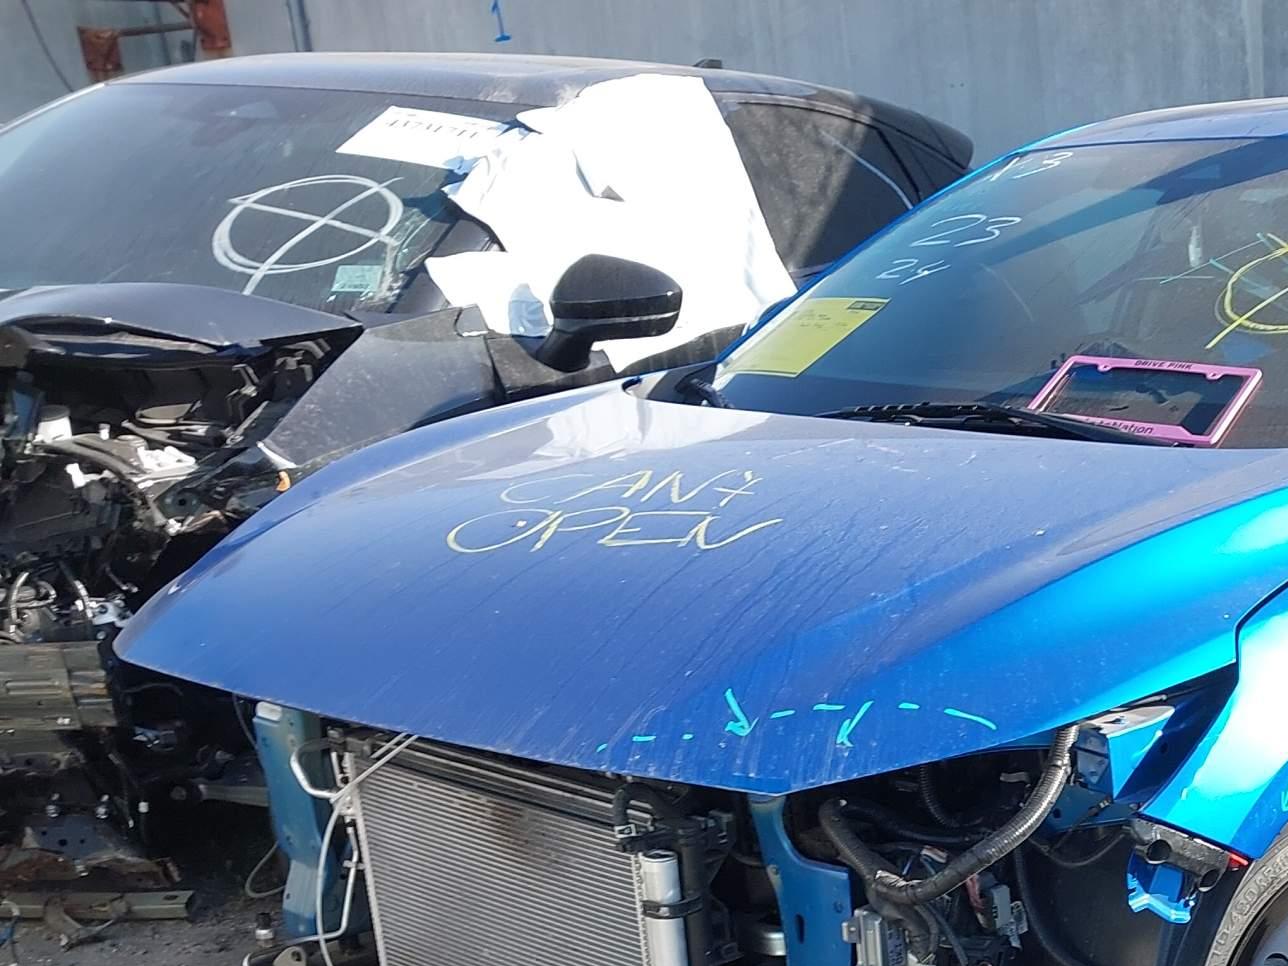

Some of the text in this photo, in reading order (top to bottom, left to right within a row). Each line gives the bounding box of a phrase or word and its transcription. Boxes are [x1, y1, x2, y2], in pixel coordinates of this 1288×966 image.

[909, 213, 1023, 248] 23
[874, 258, 952, 286] 24
[1134, 360, 1165, 368] DRIVE
[446, 506, 783, 554] OPEN
